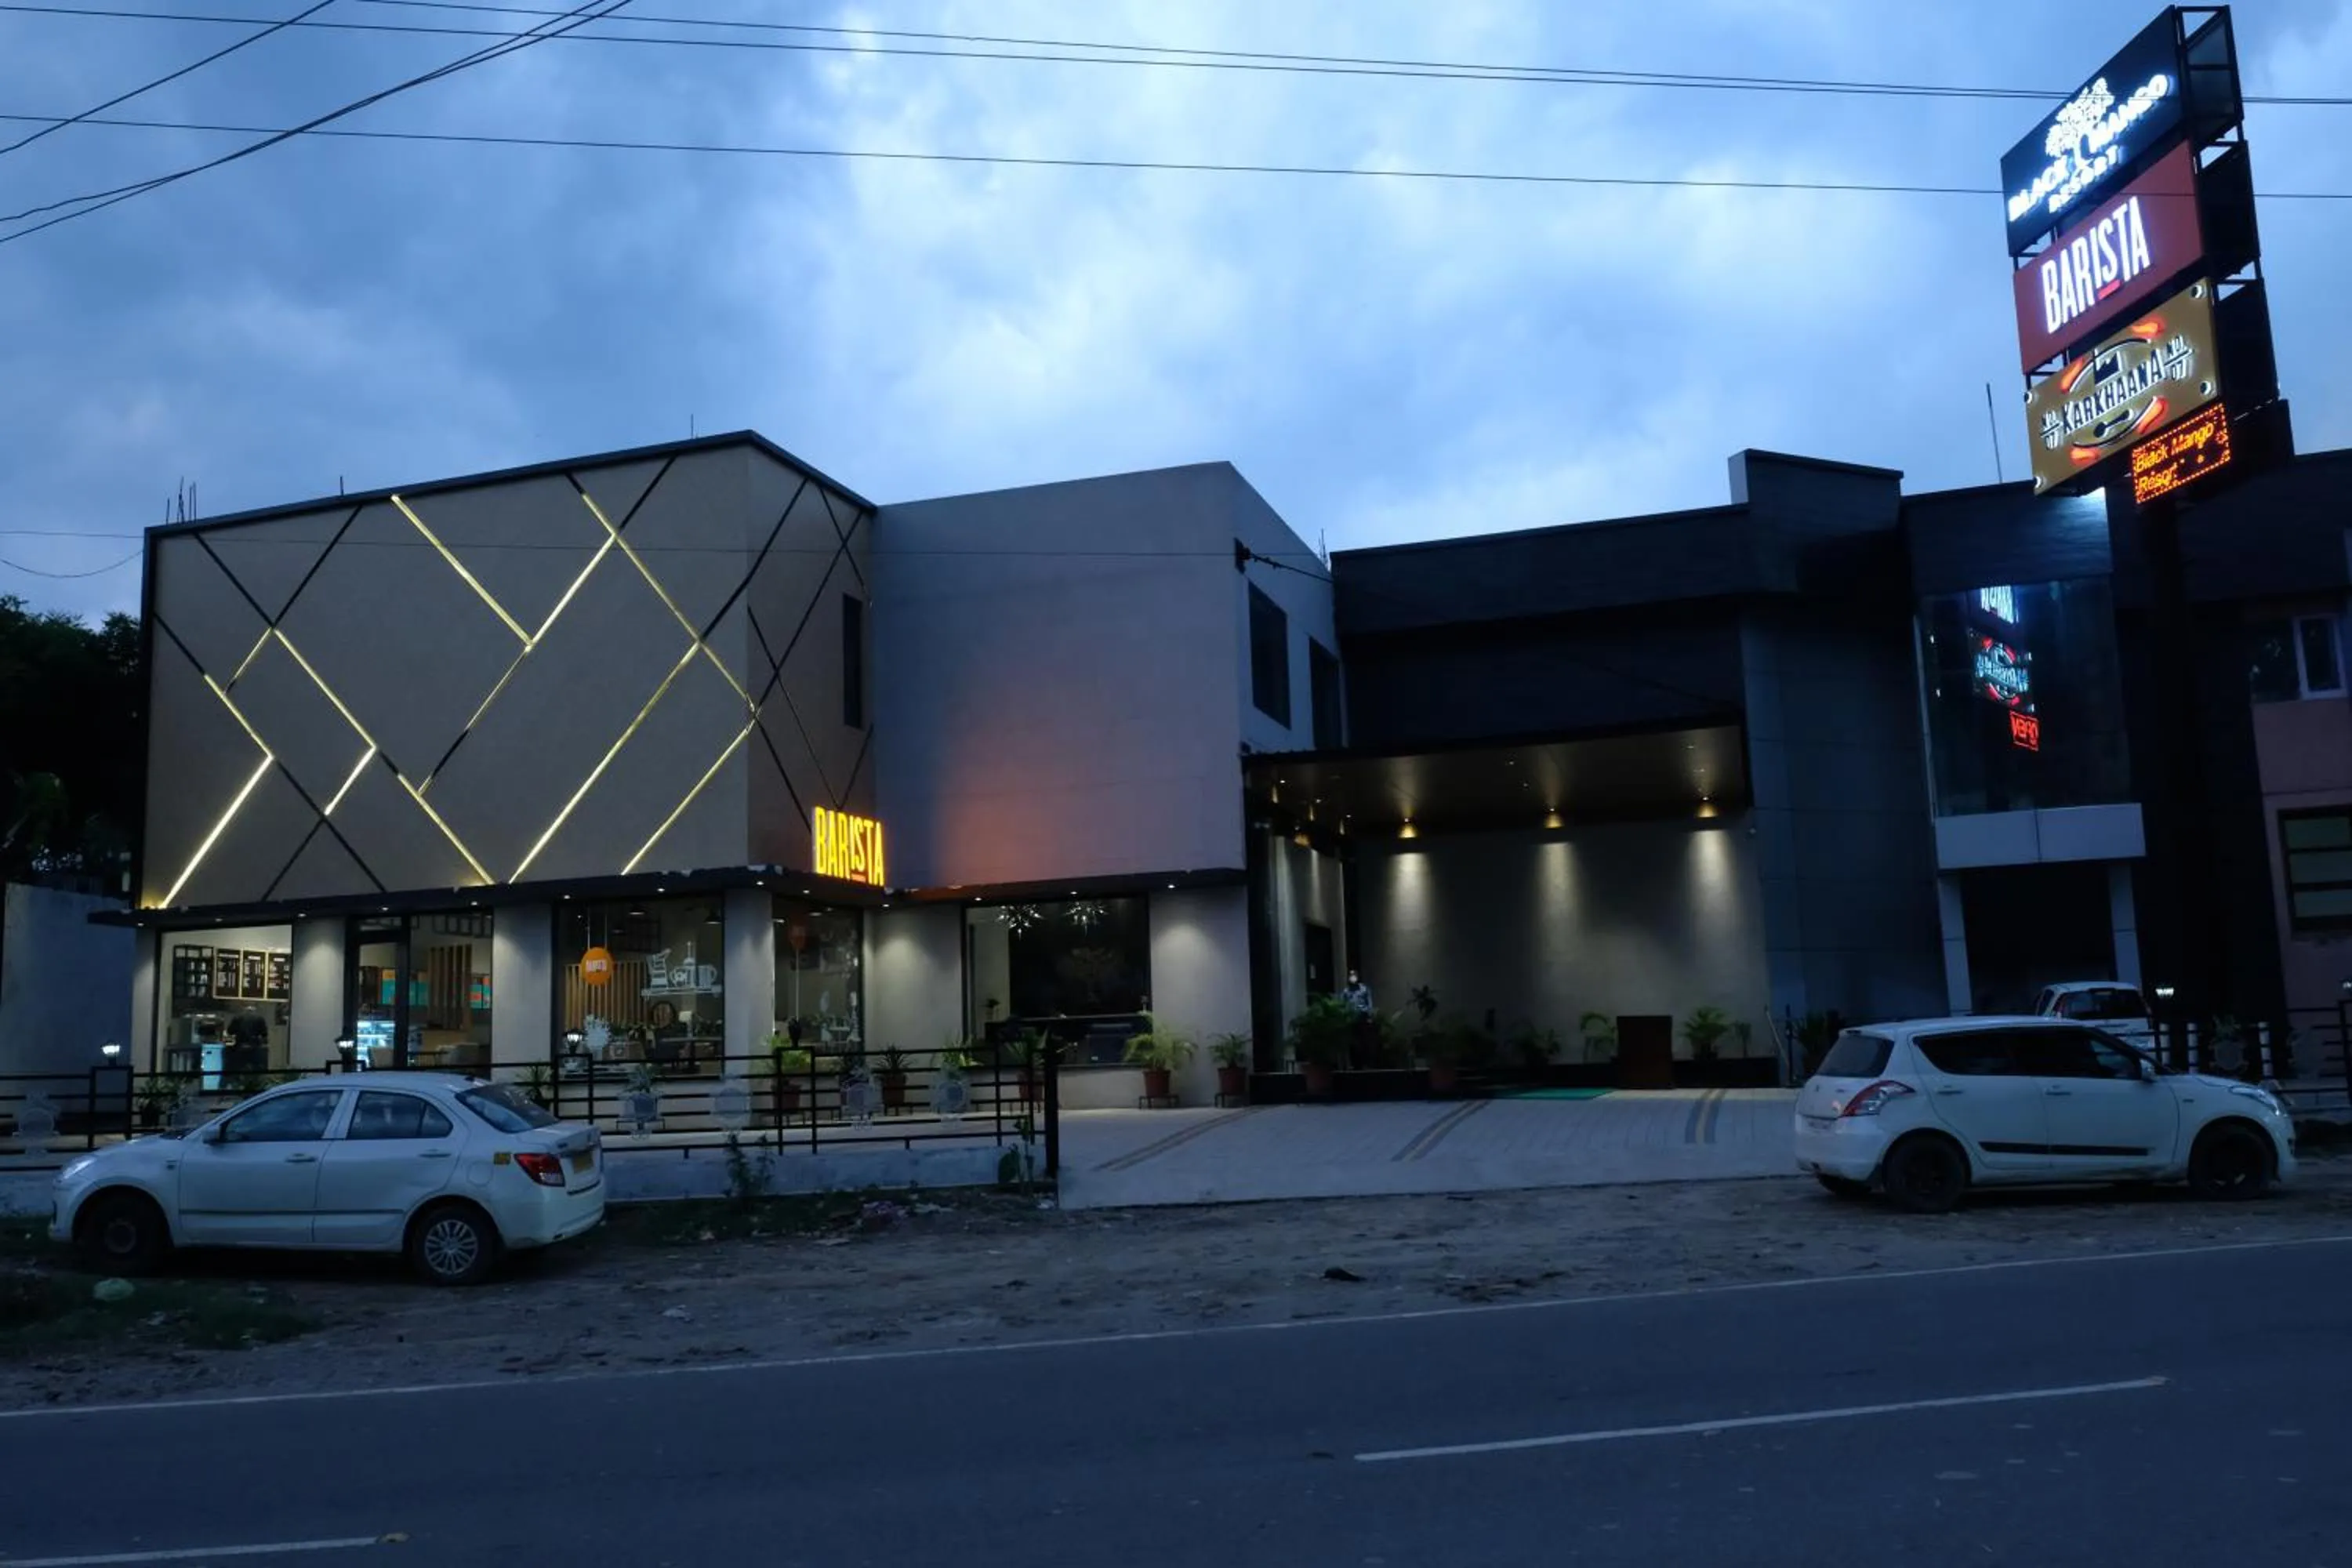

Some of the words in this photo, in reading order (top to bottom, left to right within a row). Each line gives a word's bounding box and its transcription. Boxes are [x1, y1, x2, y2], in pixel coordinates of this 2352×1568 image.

[2041, 195, 2151, 334] BARISTA
[2062, 348, 2165, 435] KARKHAANA
[813, 805, 885, 887] BARISTA
